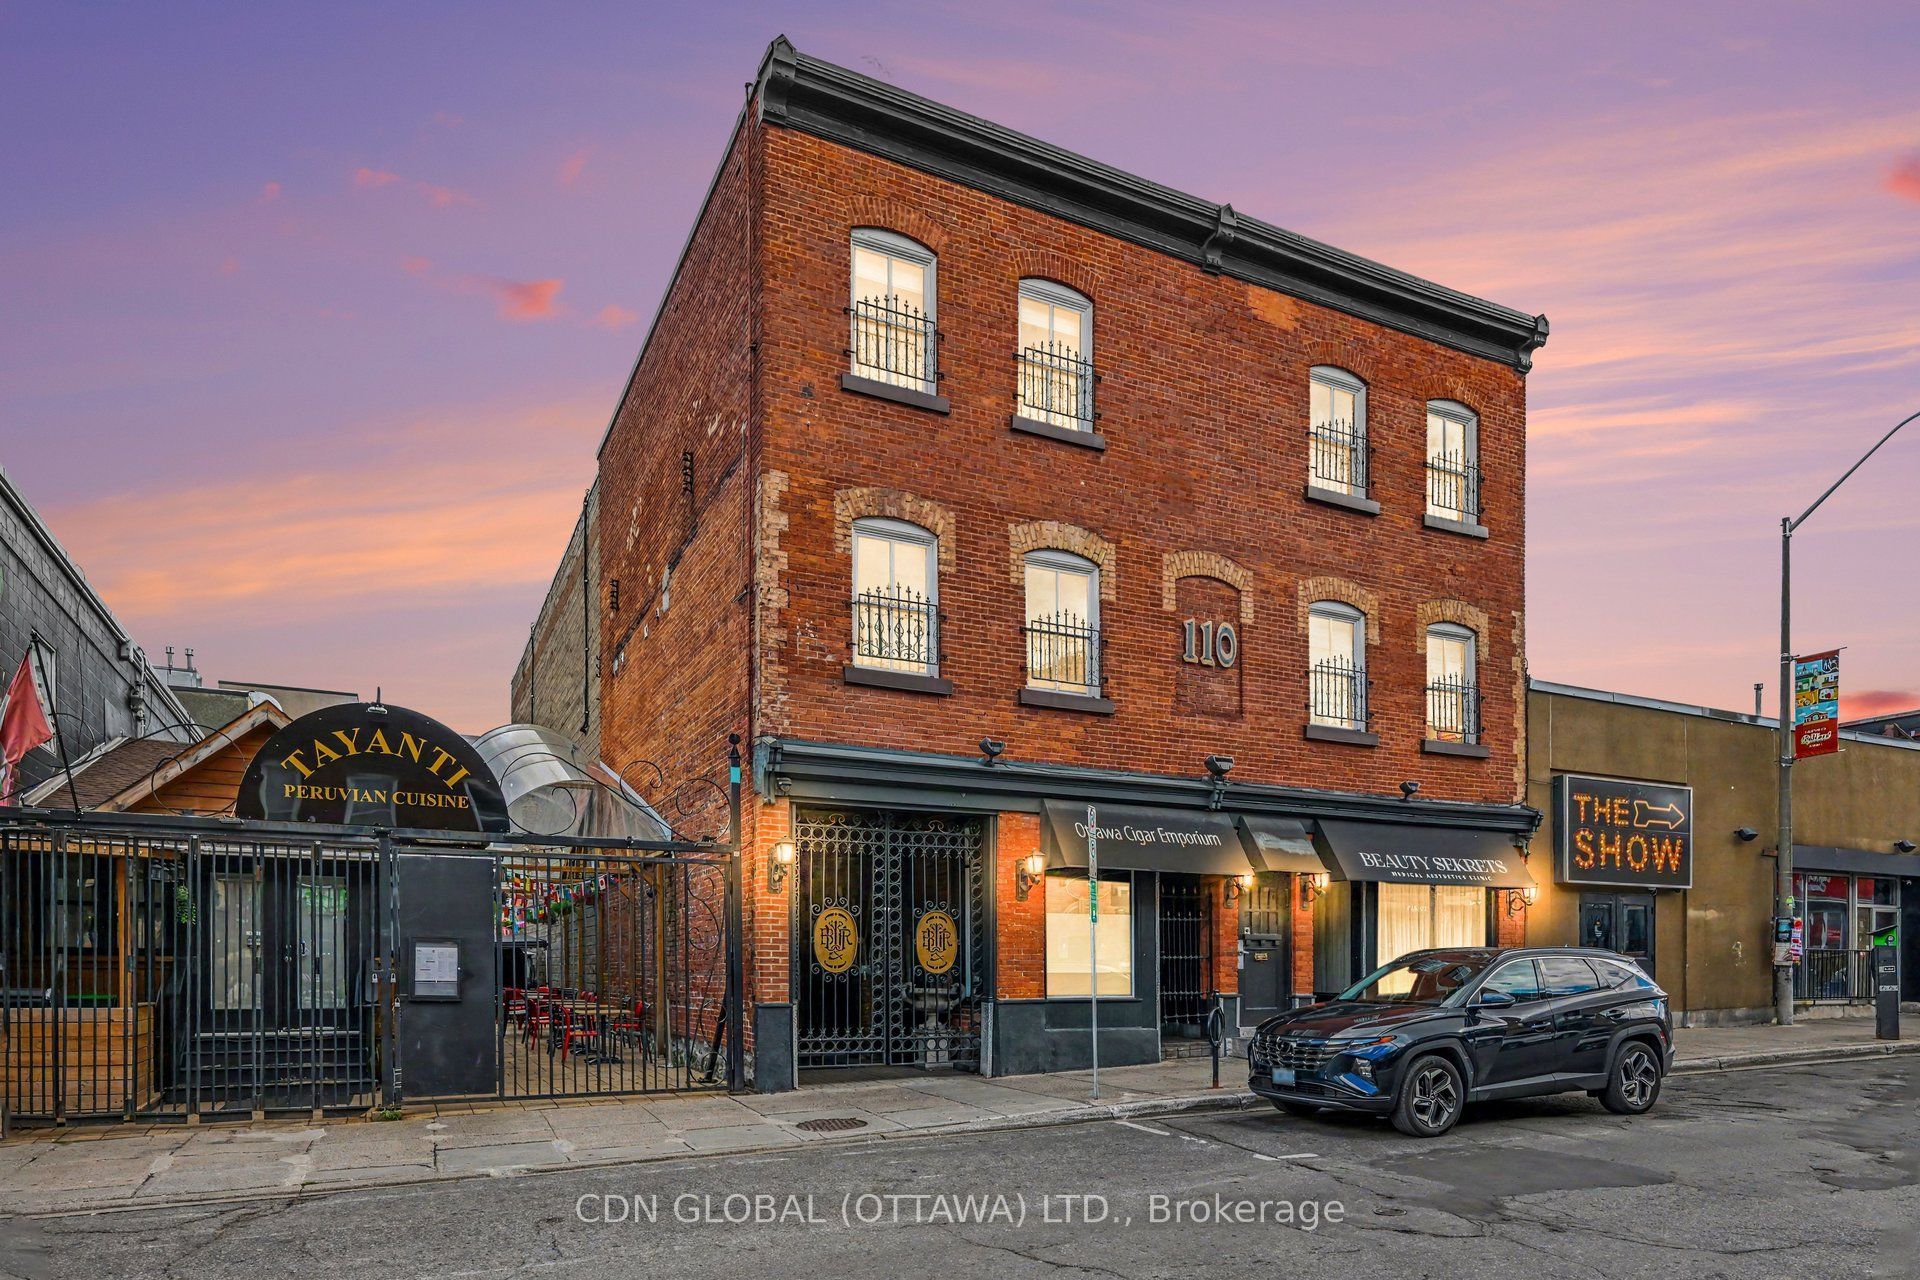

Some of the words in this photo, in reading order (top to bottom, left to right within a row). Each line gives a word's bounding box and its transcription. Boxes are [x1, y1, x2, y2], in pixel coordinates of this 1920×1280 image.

[1182, 618, 1238, 668] 110
[280, 727, 471, 790] TAYANTI
[283, 784, 387, 804] PERUVIAN
[392, 791, 469, 809] CUISINE
[1573, 792, 1630, 827] THE
[1123, 825, 1155, 846] Cigar
[1157, 827, 1222, 848] Emporium
[1573, 828, 1683, 875] SHOW
[1359, 852, 1431, 870] BEAUTY
[1432, 856, 1508, 874] SEKRETS
